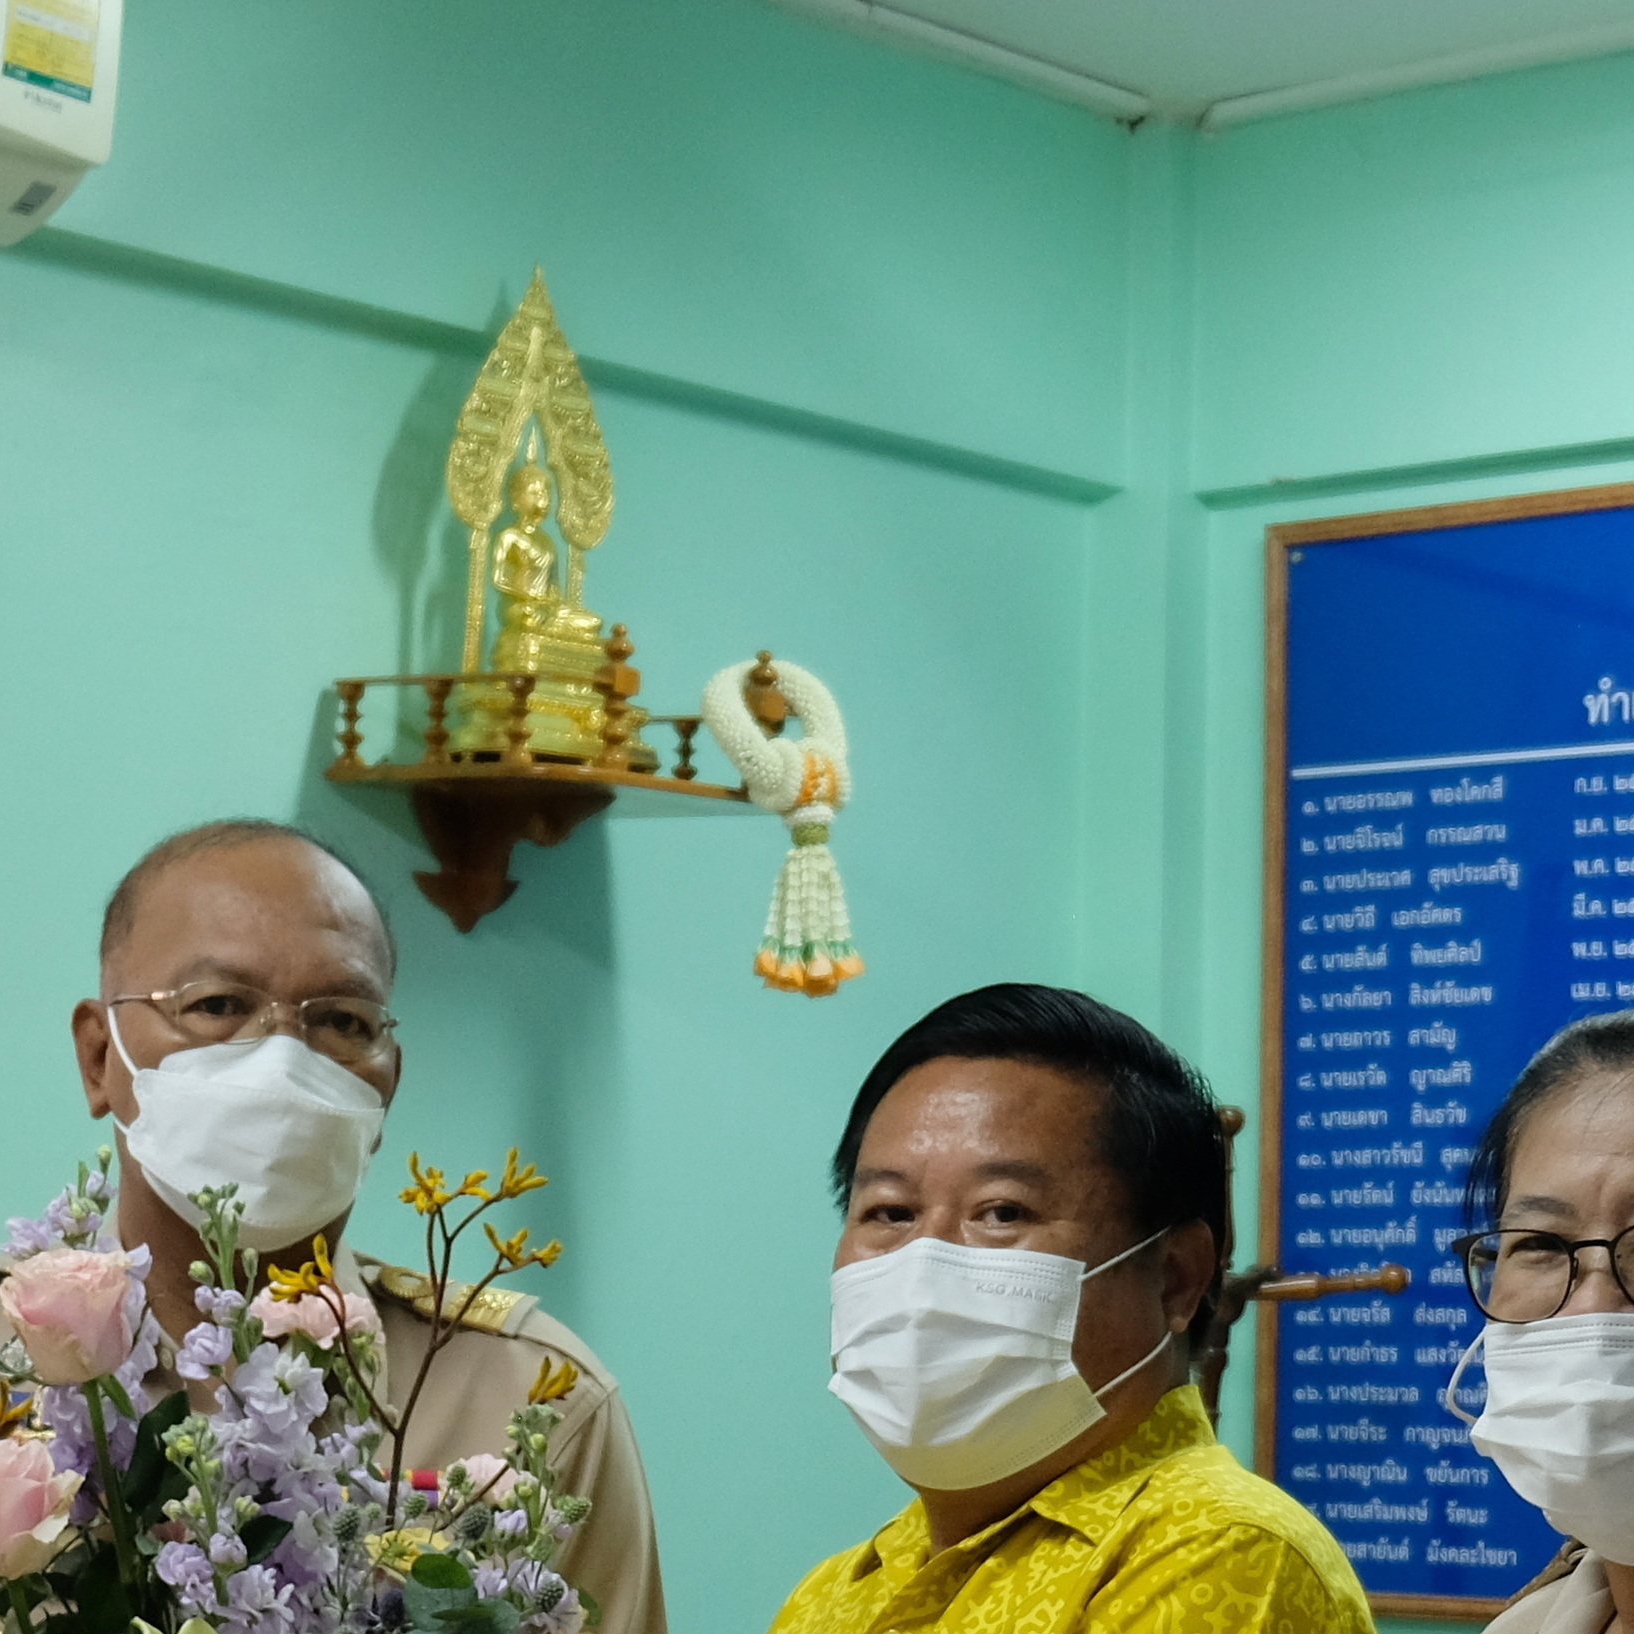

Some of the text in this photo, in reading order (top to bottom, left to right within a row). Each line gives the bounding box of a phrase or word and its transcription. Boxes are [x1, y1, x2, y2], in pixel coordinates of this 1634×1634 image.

[1301, 838, 1319, 854] ๒.
[1300, 880, 1318, 892] ๓.
[1428, 857, 1521, 891] สุขประเสริฐ
[1298, 1153, 1326, 1166] ๑๐.
[1297, 1192, 1325, 1204] ๑๑.
[1297, 1230, 1325, 1244] ๑๒.
[1331, 1216, 1417, 1250] นายอนุศักดิ์
